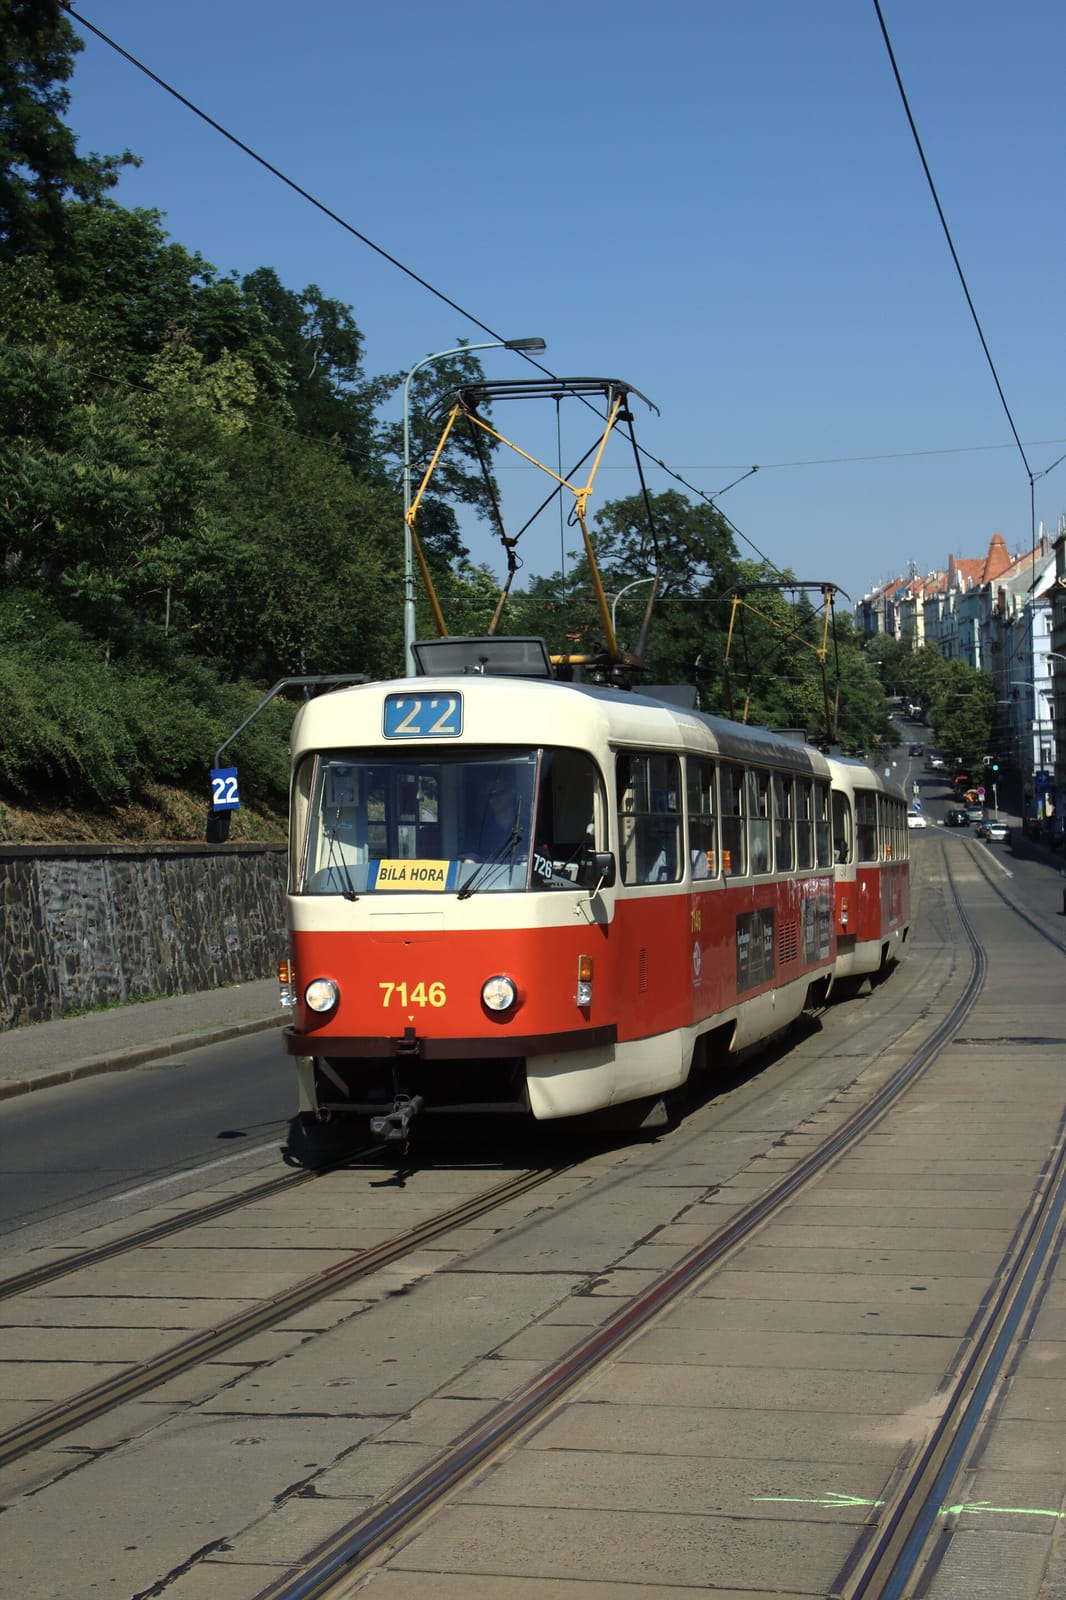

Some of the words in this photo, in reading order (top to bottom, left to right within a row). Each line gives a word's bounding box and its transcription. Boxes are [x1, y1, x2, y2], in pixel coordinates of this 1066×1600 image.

[394, 697, 456, 733] 22
[212, 777, 239, 804] 22
[379, 865, 406, 881] BÍLÁ
[410, 868, 444, 882] HORA
[379, 982, 446, 1008] 7146
